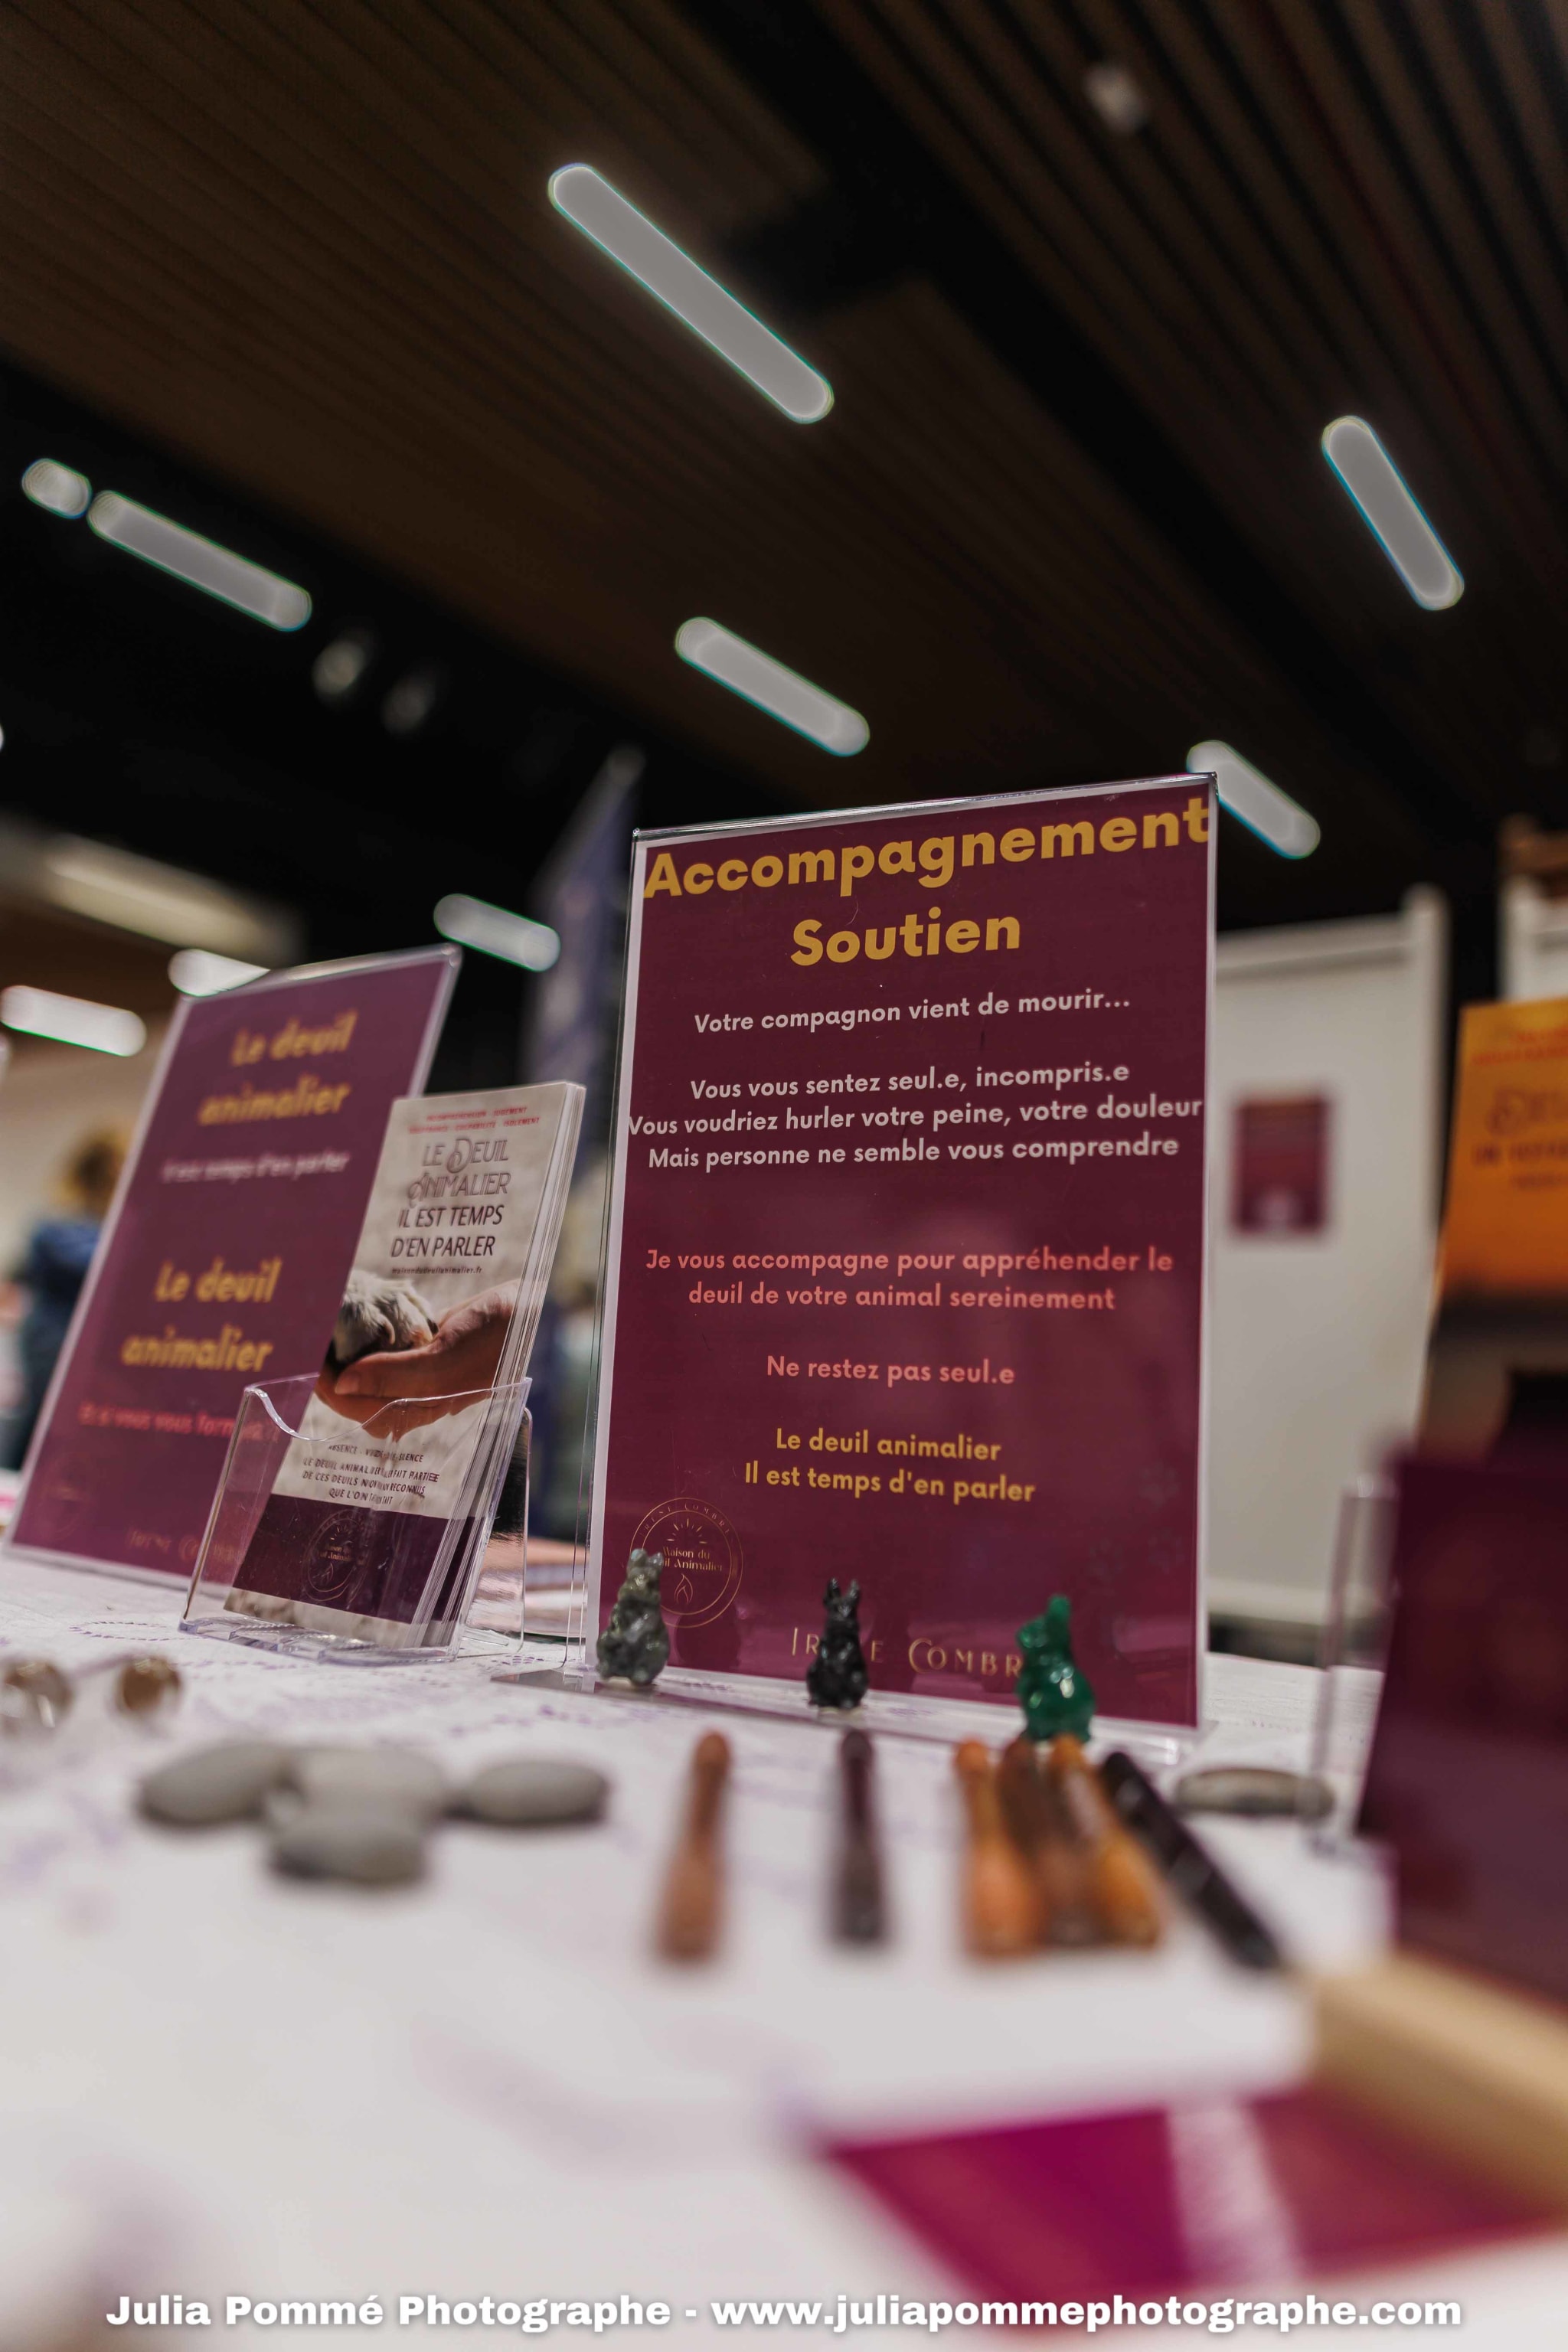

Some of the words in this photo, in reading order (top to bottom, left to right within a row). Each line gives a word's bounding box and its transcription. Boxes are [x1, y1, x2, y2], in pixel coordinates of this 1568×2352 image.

[642, 797, 1210, 898] Accompagnement
[790, 906, 1021, 966] Soutien
[694, 1014, 754, 1034] Votre
[761, 1007, 900, 1033] compagnon
[908, 998, 970, 1020] vient
[978, 991, 1010, 1015] de
[1018, 988, 1130, 1013] mourir...
[270, 1008, 358, 1060] deuil
[690, 1080, 742, 1099] Vous
[748, 1081, 799, 1097] vous
[805, 1073, 880, 1095] sentez
[887, 1065, 967, 1092] seul.e,
[976, 1060, 1129, 1091] incompris.e
[628, 1116, 678, 1136] Vous
[684, 1109, 779, 1133] voudriez
[786, 1105, 855, 1129] hurler
[861, 1106, 924, 1127] votre
[933, 1102, 1011, 1132] peine,
[1019, 1100, 1088, 1122] votre
[1096, 1093, 1203, 1119] douleur
[422, 1144, 446, 1166] LE
[648, 1147, 699, 1168] Mais
[706, 1149, 810, 1174] personne
[818, 1148, 846, 1163] ne
[854, 1137, 940, 1162] semble
[947, 1144, 1004, 1160] vous
[1011, 1130, 1179, 1165] comprendre
[407, 1171, 511, 1208] ANIMALIER
[398, 1209, 410, 1228] IL
[415, 1208, 447, 1227] EST
[449, 1204, 505, 1227] TEMPS
[390, 1237, 430, 1257] D'EN
[432, 1236, 496, 1257] PARLER
[645, 1249, 671, 1269] Je
[678, 1255, 725, 1269] vous
[732, 1254, 889, 1277] accompagne
[897, 1254, 956, 1277] pour
[962, 1246, 1139, 1278] appréhender
[1148, 1246, 1173, 1271] le
[155, 1262, 190, 1302] Le
[196, 1256, 282, 1302] deuil
[688, 1281, 743, 1304] deuil
[750, 1281, 779, 1305] de
[786, 1285, 848, 1305] votre
[855, 1282, 941, 1306] animal
[950, 1285, 1114, 1309] sereinement
[122, 1323, 274, 1372] animalier
[767, 1355, 799, 1377] Ne
[808, 1359, 879, 1380] restez
[887, 1365, 932, 1388] pas
[939, 1357, 1014, 1384] seul.e
[776, 1427, 801, 1450] Le
[808, 1427, 869, 1453] deuil
[877, 1433, 1001, 1461] animalier
[329, 1488, 345, 1498] QUE
[331, 1475, 358, 1486] DEUILS
[745, 1460, 759, 1484] Il
[766, 1466, 800, 1487] est
[807, 1468, 881, 1499] temps
[889, 1468, 945, 1496] d'en
[953, 1474, 1036, 1505] parler
[792, 1627, 884, 1664] IRE
